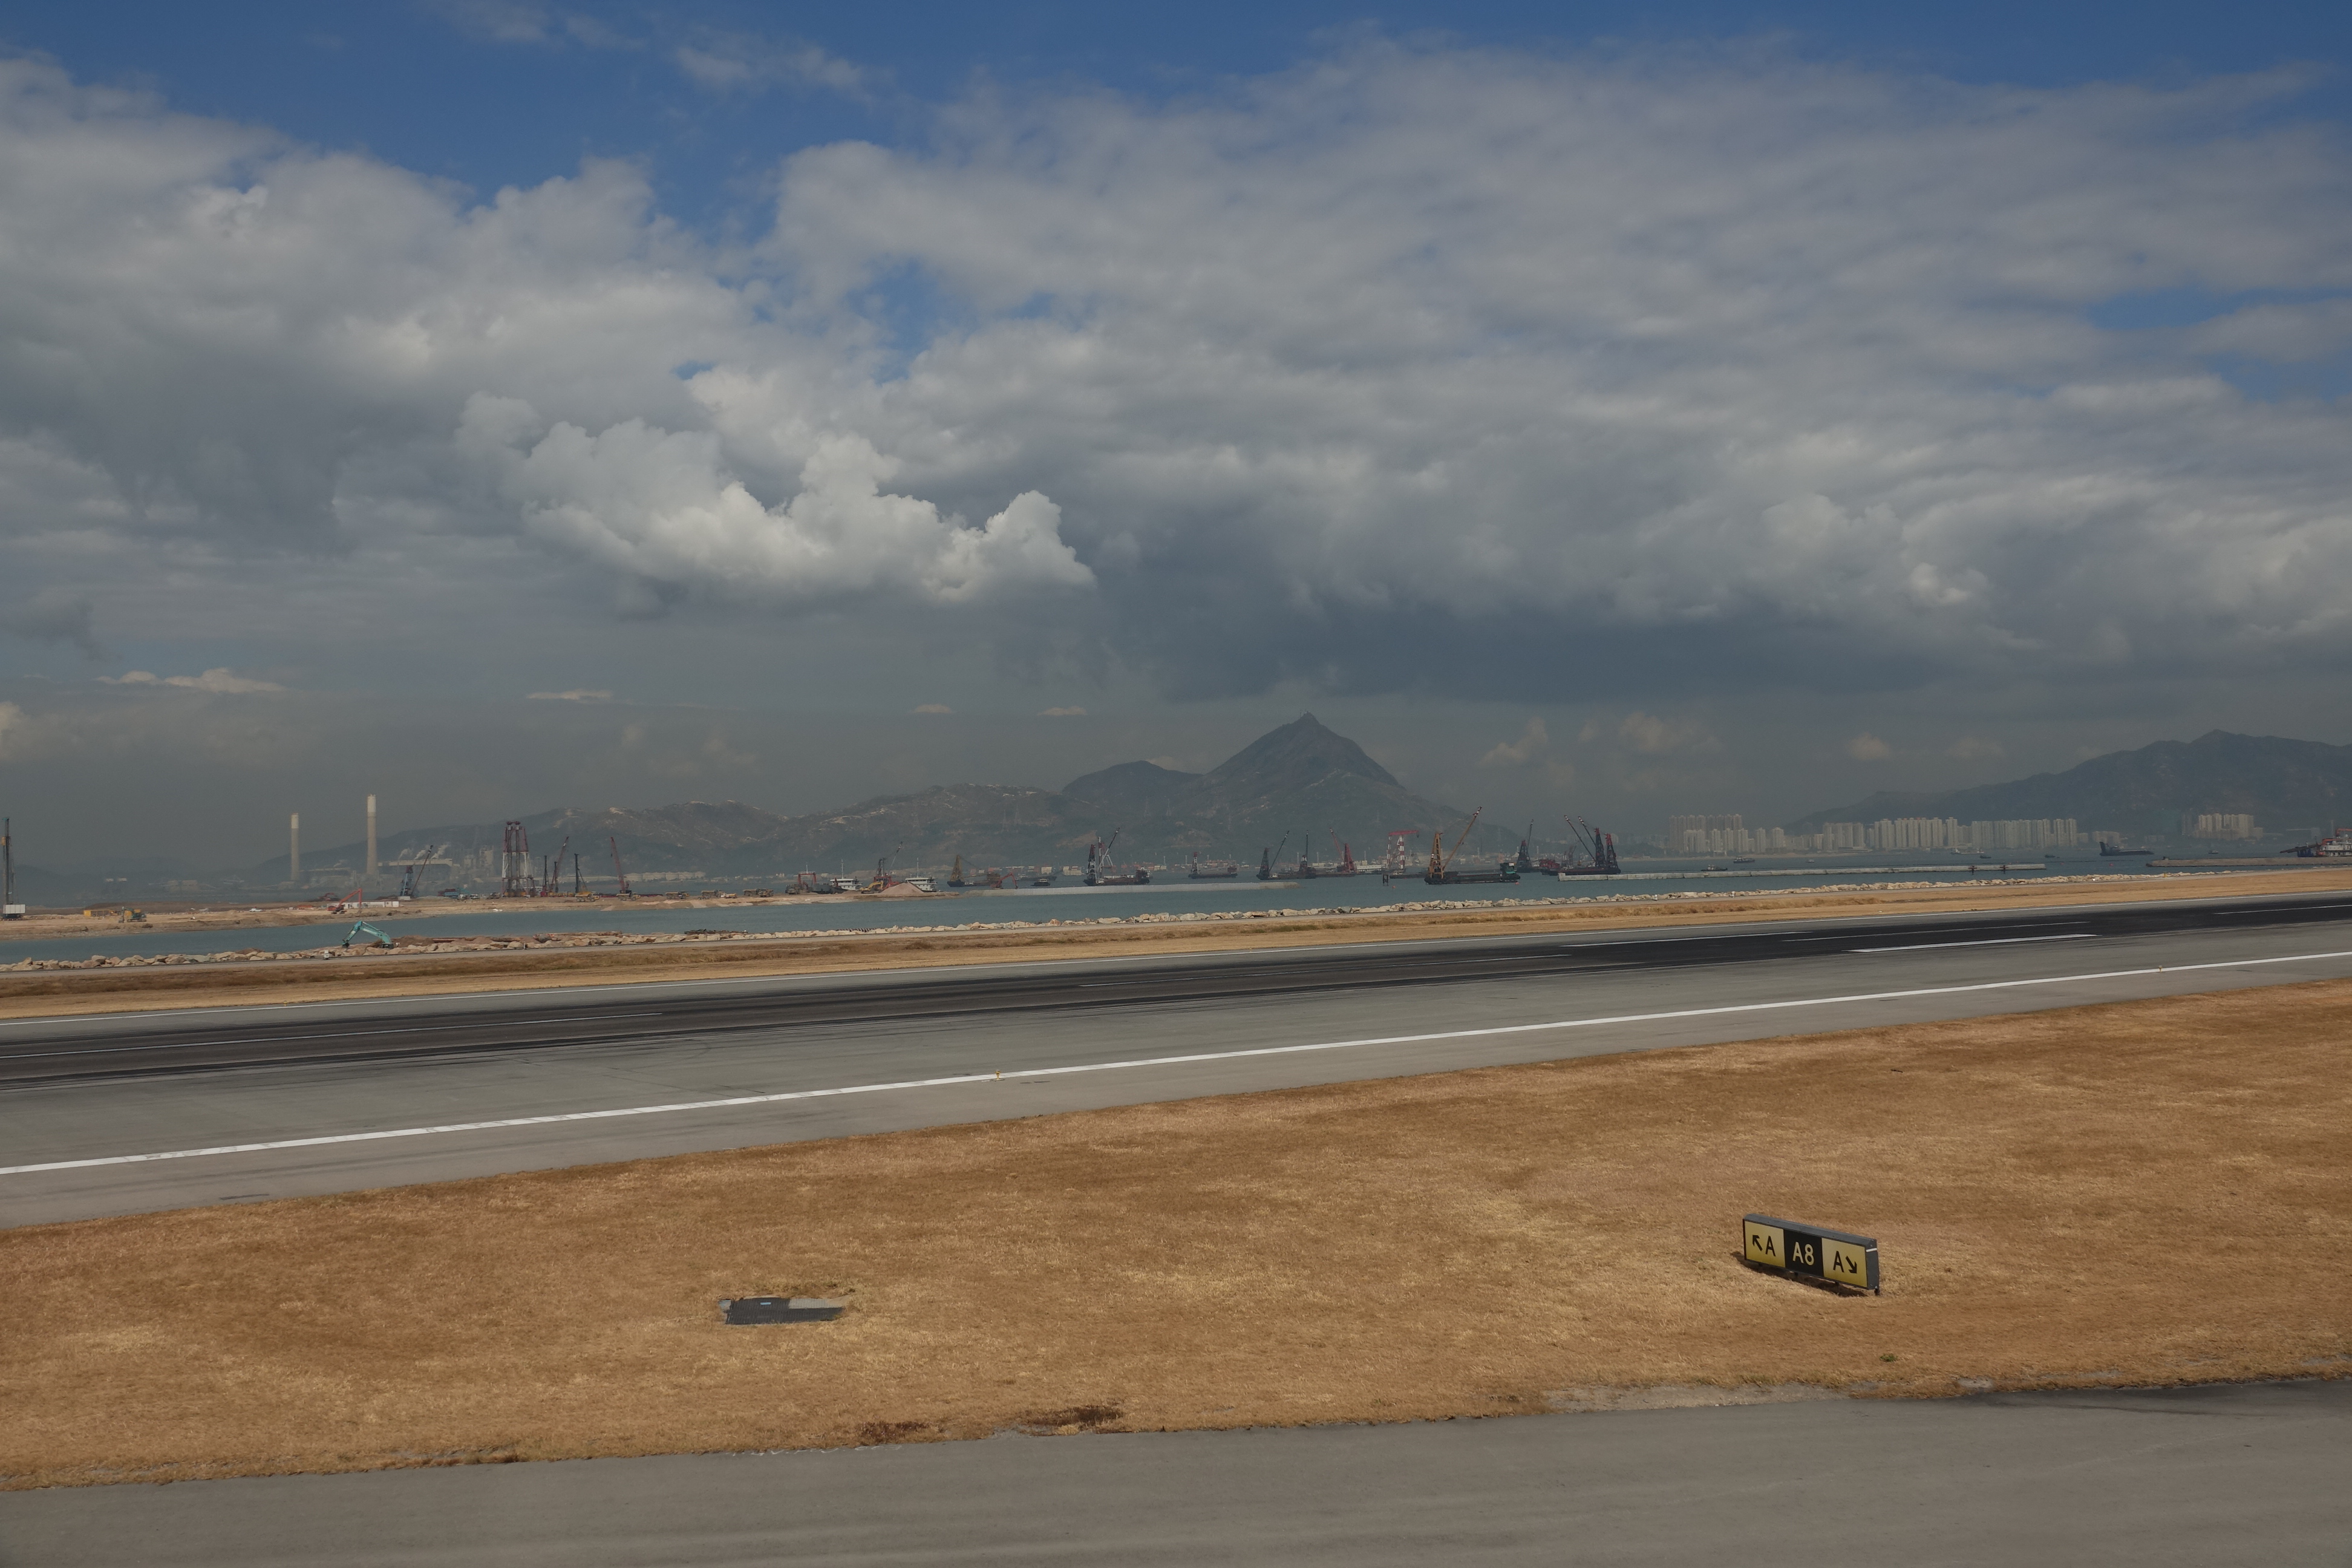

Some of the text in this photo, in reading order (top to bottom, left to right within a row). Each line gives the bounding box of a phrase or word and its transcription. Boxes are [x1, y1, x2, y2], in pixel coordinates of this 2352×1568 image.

[1765, 1235, 1844, 1273] A A8 A
